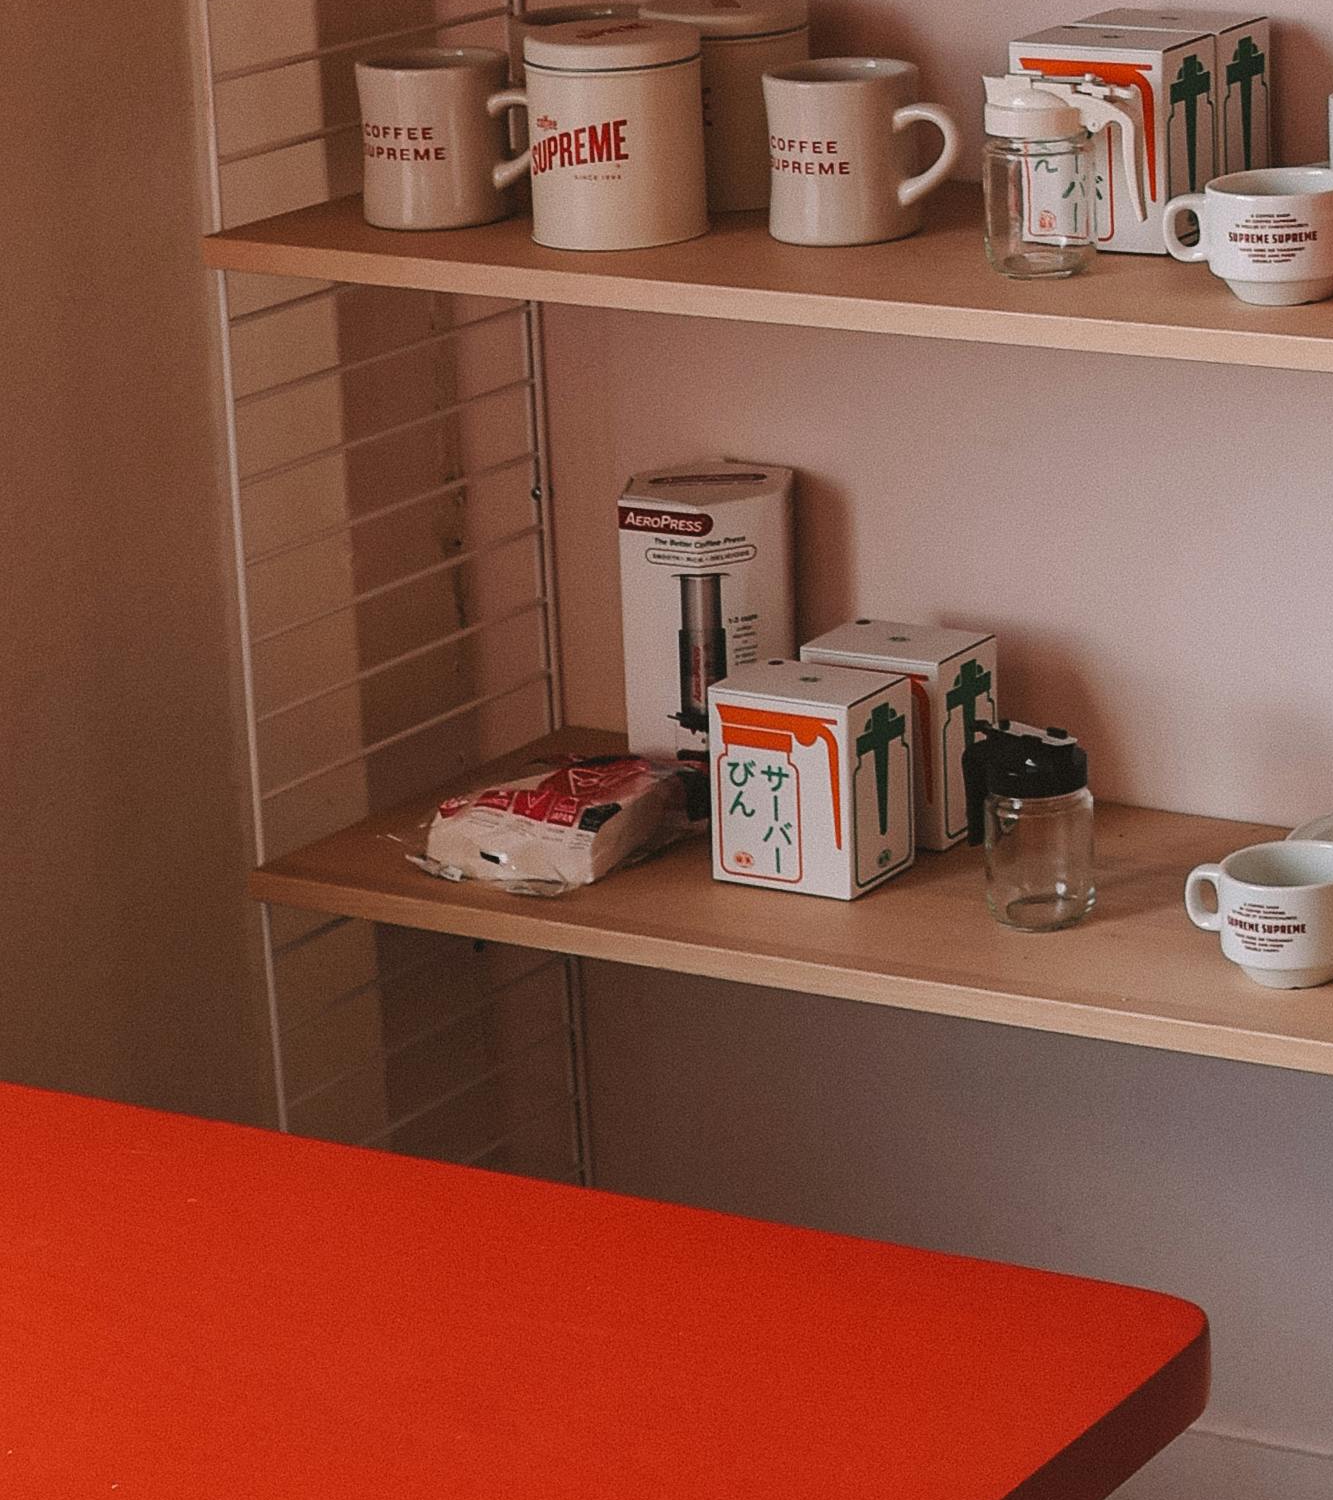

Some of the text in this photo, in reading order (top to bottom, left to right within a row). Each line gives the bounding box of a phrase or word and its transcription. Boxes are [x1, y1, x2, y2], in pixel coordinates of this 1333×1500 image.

[364, 122, 434, 141] COFFEE
[531, 118, 630, 177] SUPREME
[770, 135, 838, 155] COFFEE
[1227, 231, 1318, 245] SUPREME SUPREME
[726, 760, 756, 818] びん
[761, 764, 793, 874] サーバー
[1261, 922, 1307, 935] SUPREME
